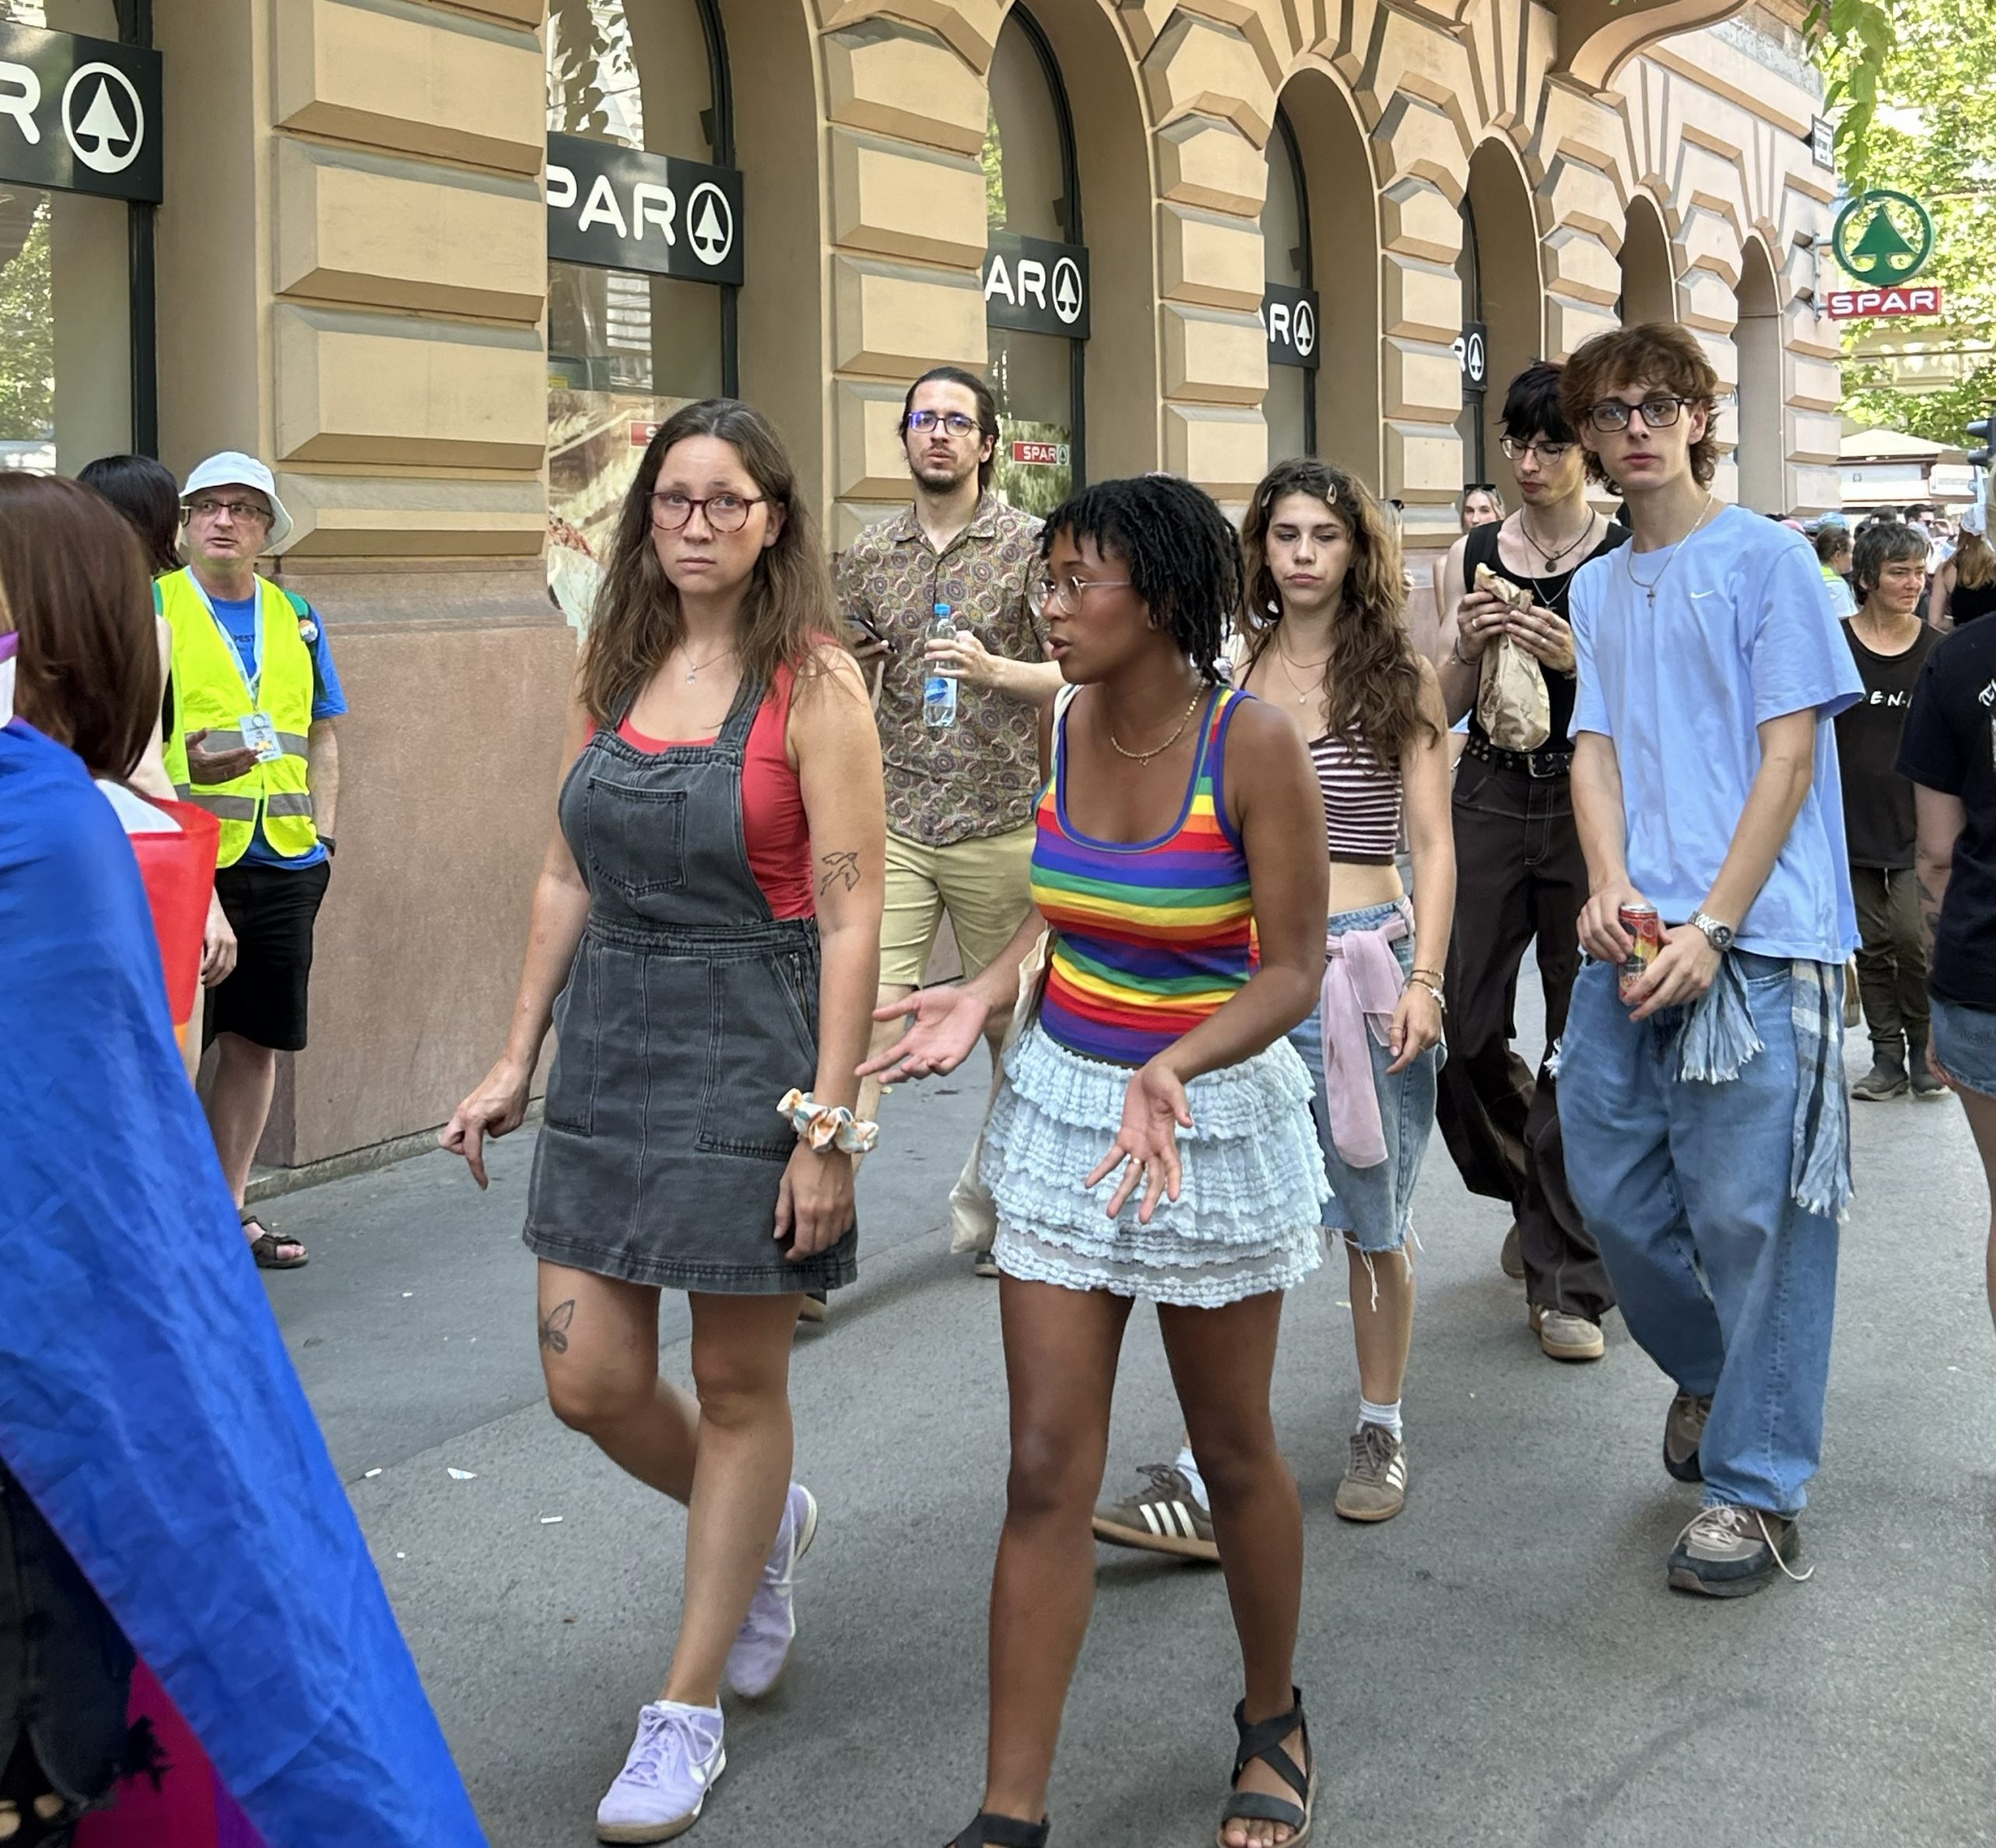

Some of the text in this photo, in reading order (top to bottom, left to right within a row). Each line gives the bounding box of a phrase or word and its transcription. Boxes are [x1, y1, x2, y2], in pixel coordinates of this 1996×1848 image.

[546, 163, 677, 246] PAR
[985, 254, 1046, 310] AR
[1831, 290, 1934, 314] SPAR
[1023, 445, 1056, 462] SPAR
